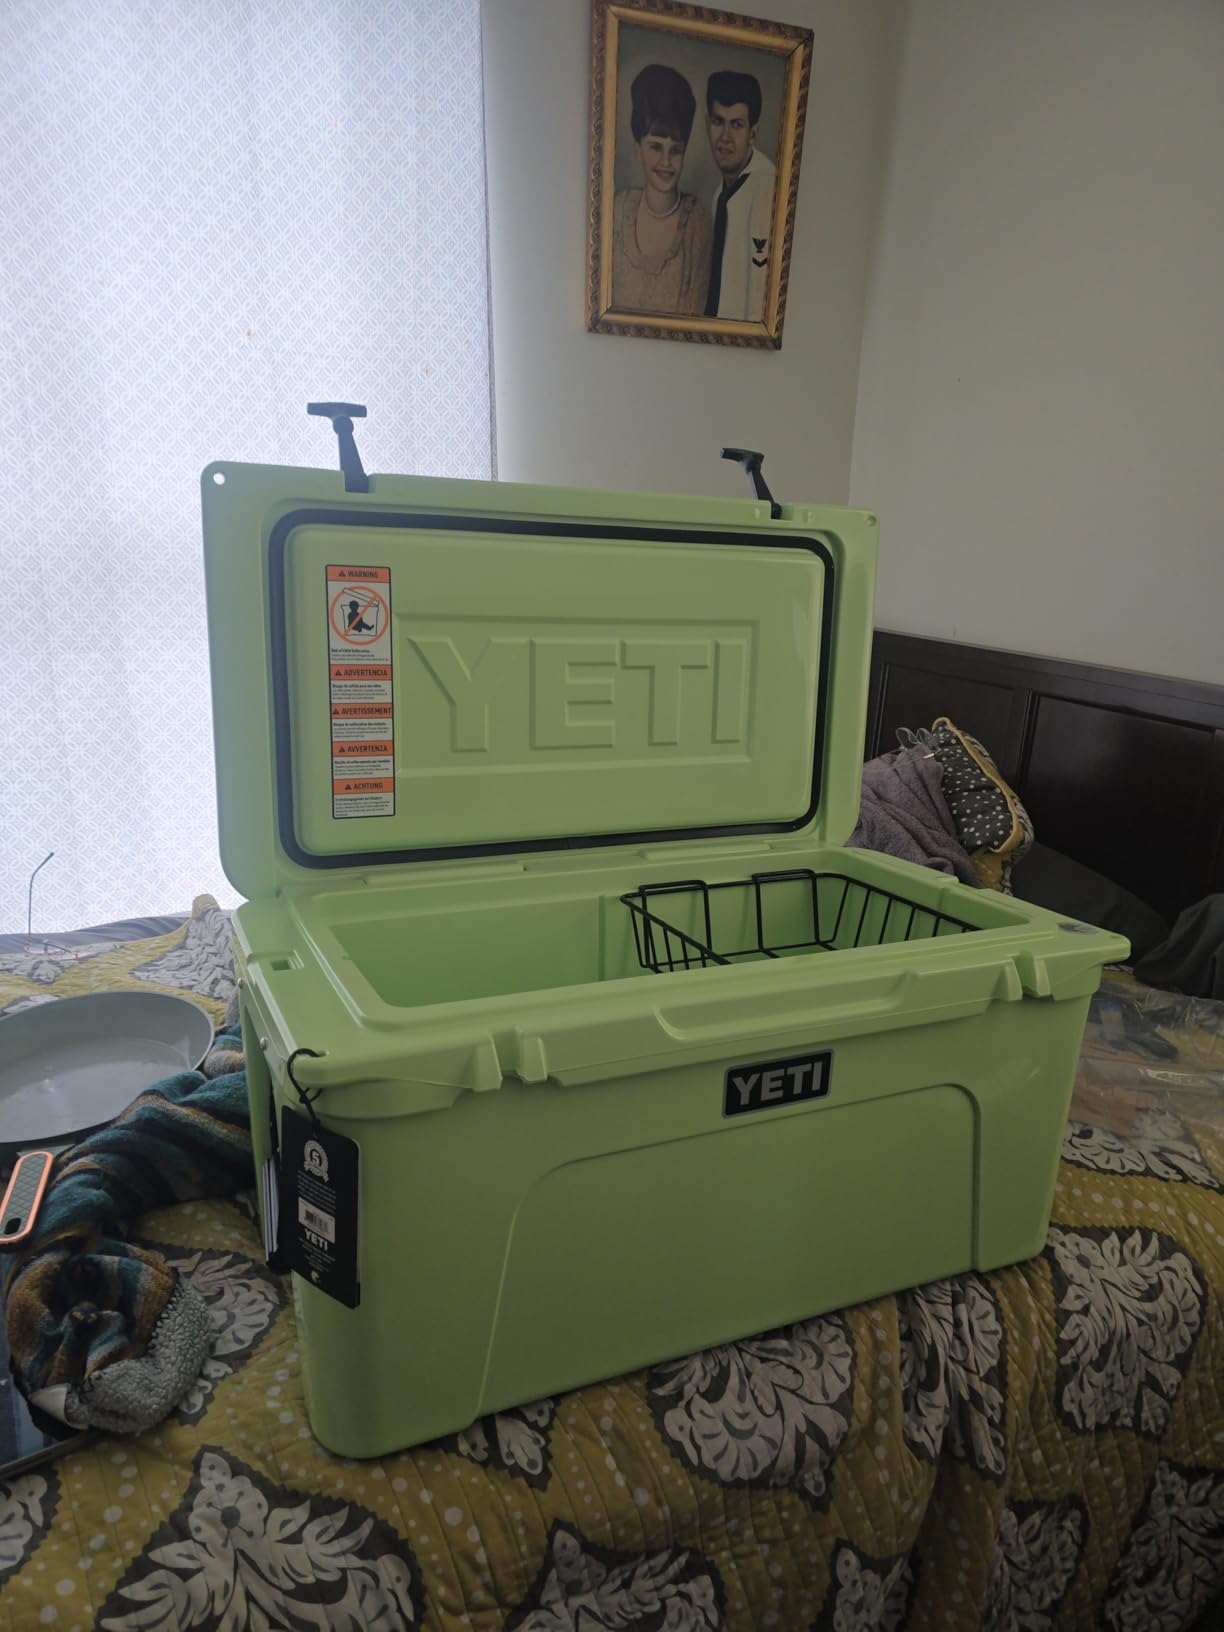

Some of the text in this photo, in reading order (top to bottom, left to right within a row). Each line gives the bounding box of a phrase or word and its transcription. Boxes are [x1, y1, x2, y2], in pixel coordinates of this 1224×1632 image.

[347, 570, 379, 578] WARNING
[343, 669, 388, 677] ADVERTENCIA
[406, 635, 747, 753] YETI
[347, 745, 388, 753] AVVERTENZA
[353, 782, 384, 790] ACHTUNG
[731, 1061, 824, 1106] YETI
[304, 1228, 328, 1251] YETI
